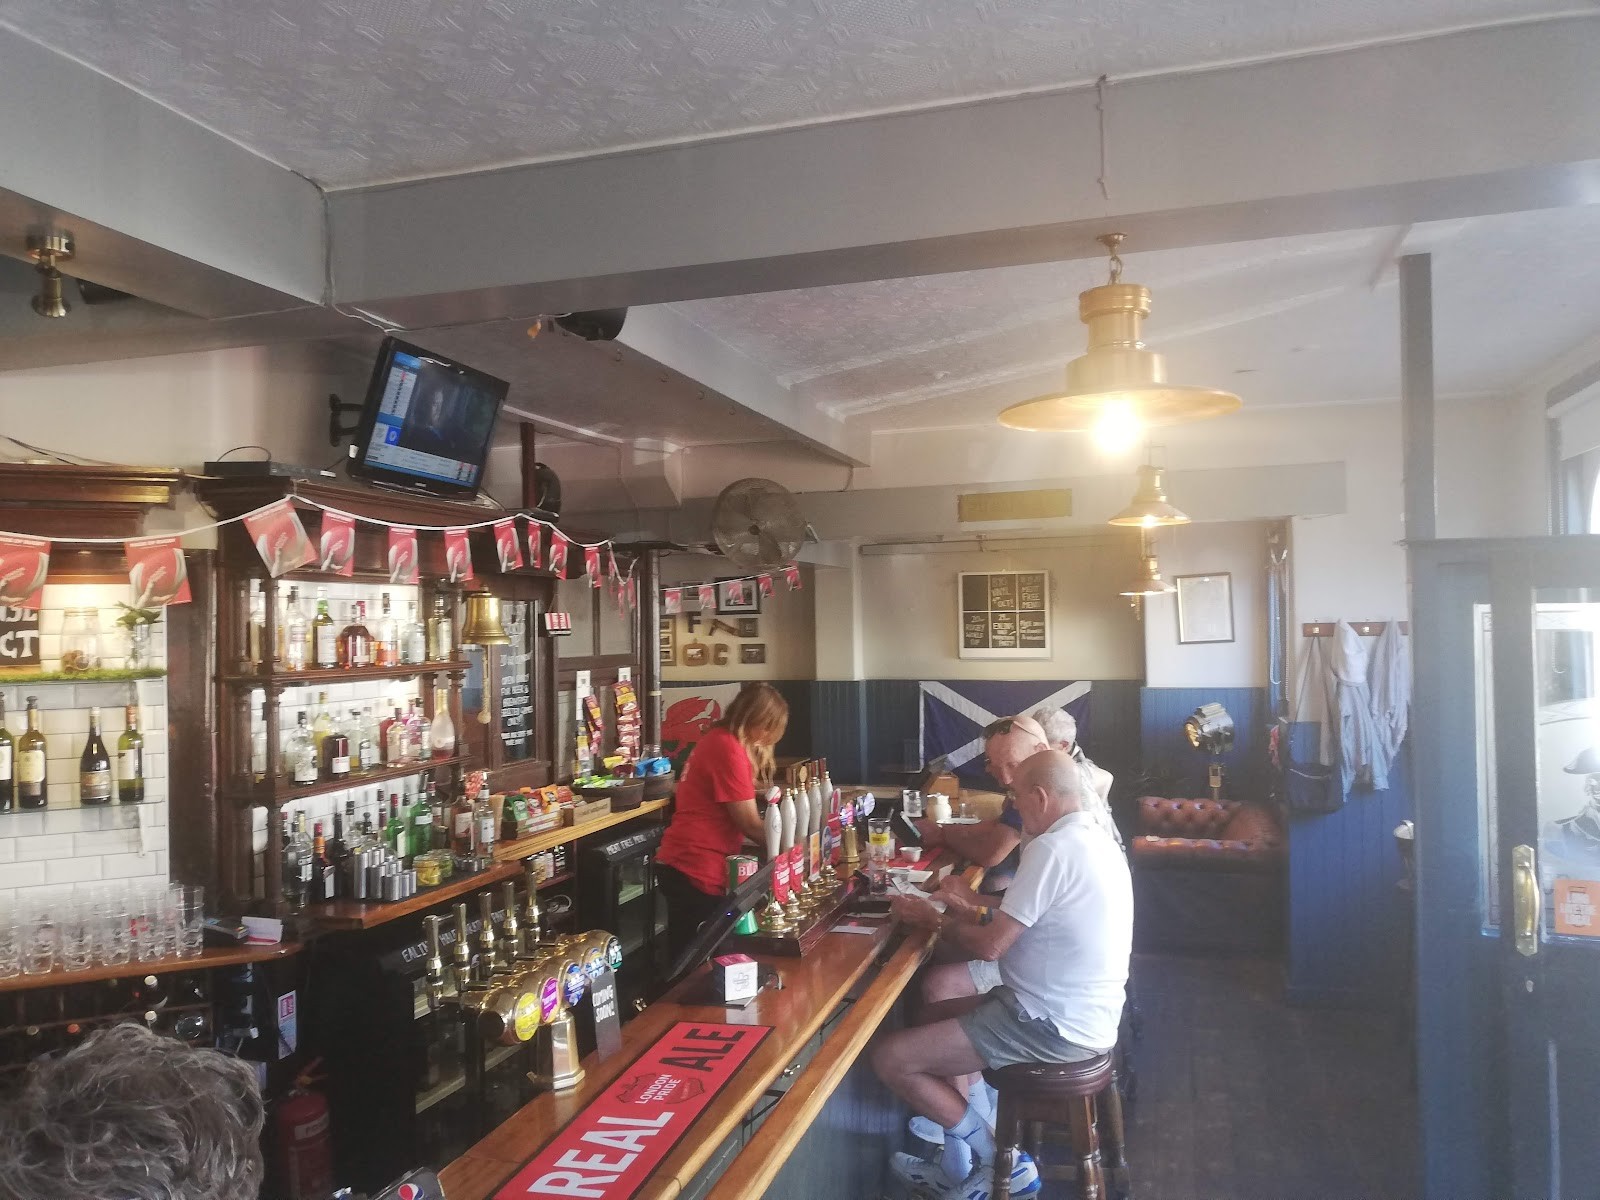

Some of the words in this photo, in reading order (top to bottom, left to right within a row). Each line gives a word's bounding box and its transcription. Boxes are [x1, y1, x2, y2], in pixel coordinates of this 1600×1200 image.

[592, 984, 614, 1007] COMING
[595, 1000, 616, 1023] SOON!
[658, 1027, 747, 1073] ALE
[635, 1073, 673, 1104] LONDON
[653, 1078, 682, 1101] PRIDE
[526, 1111, 675, 1199] REAL
